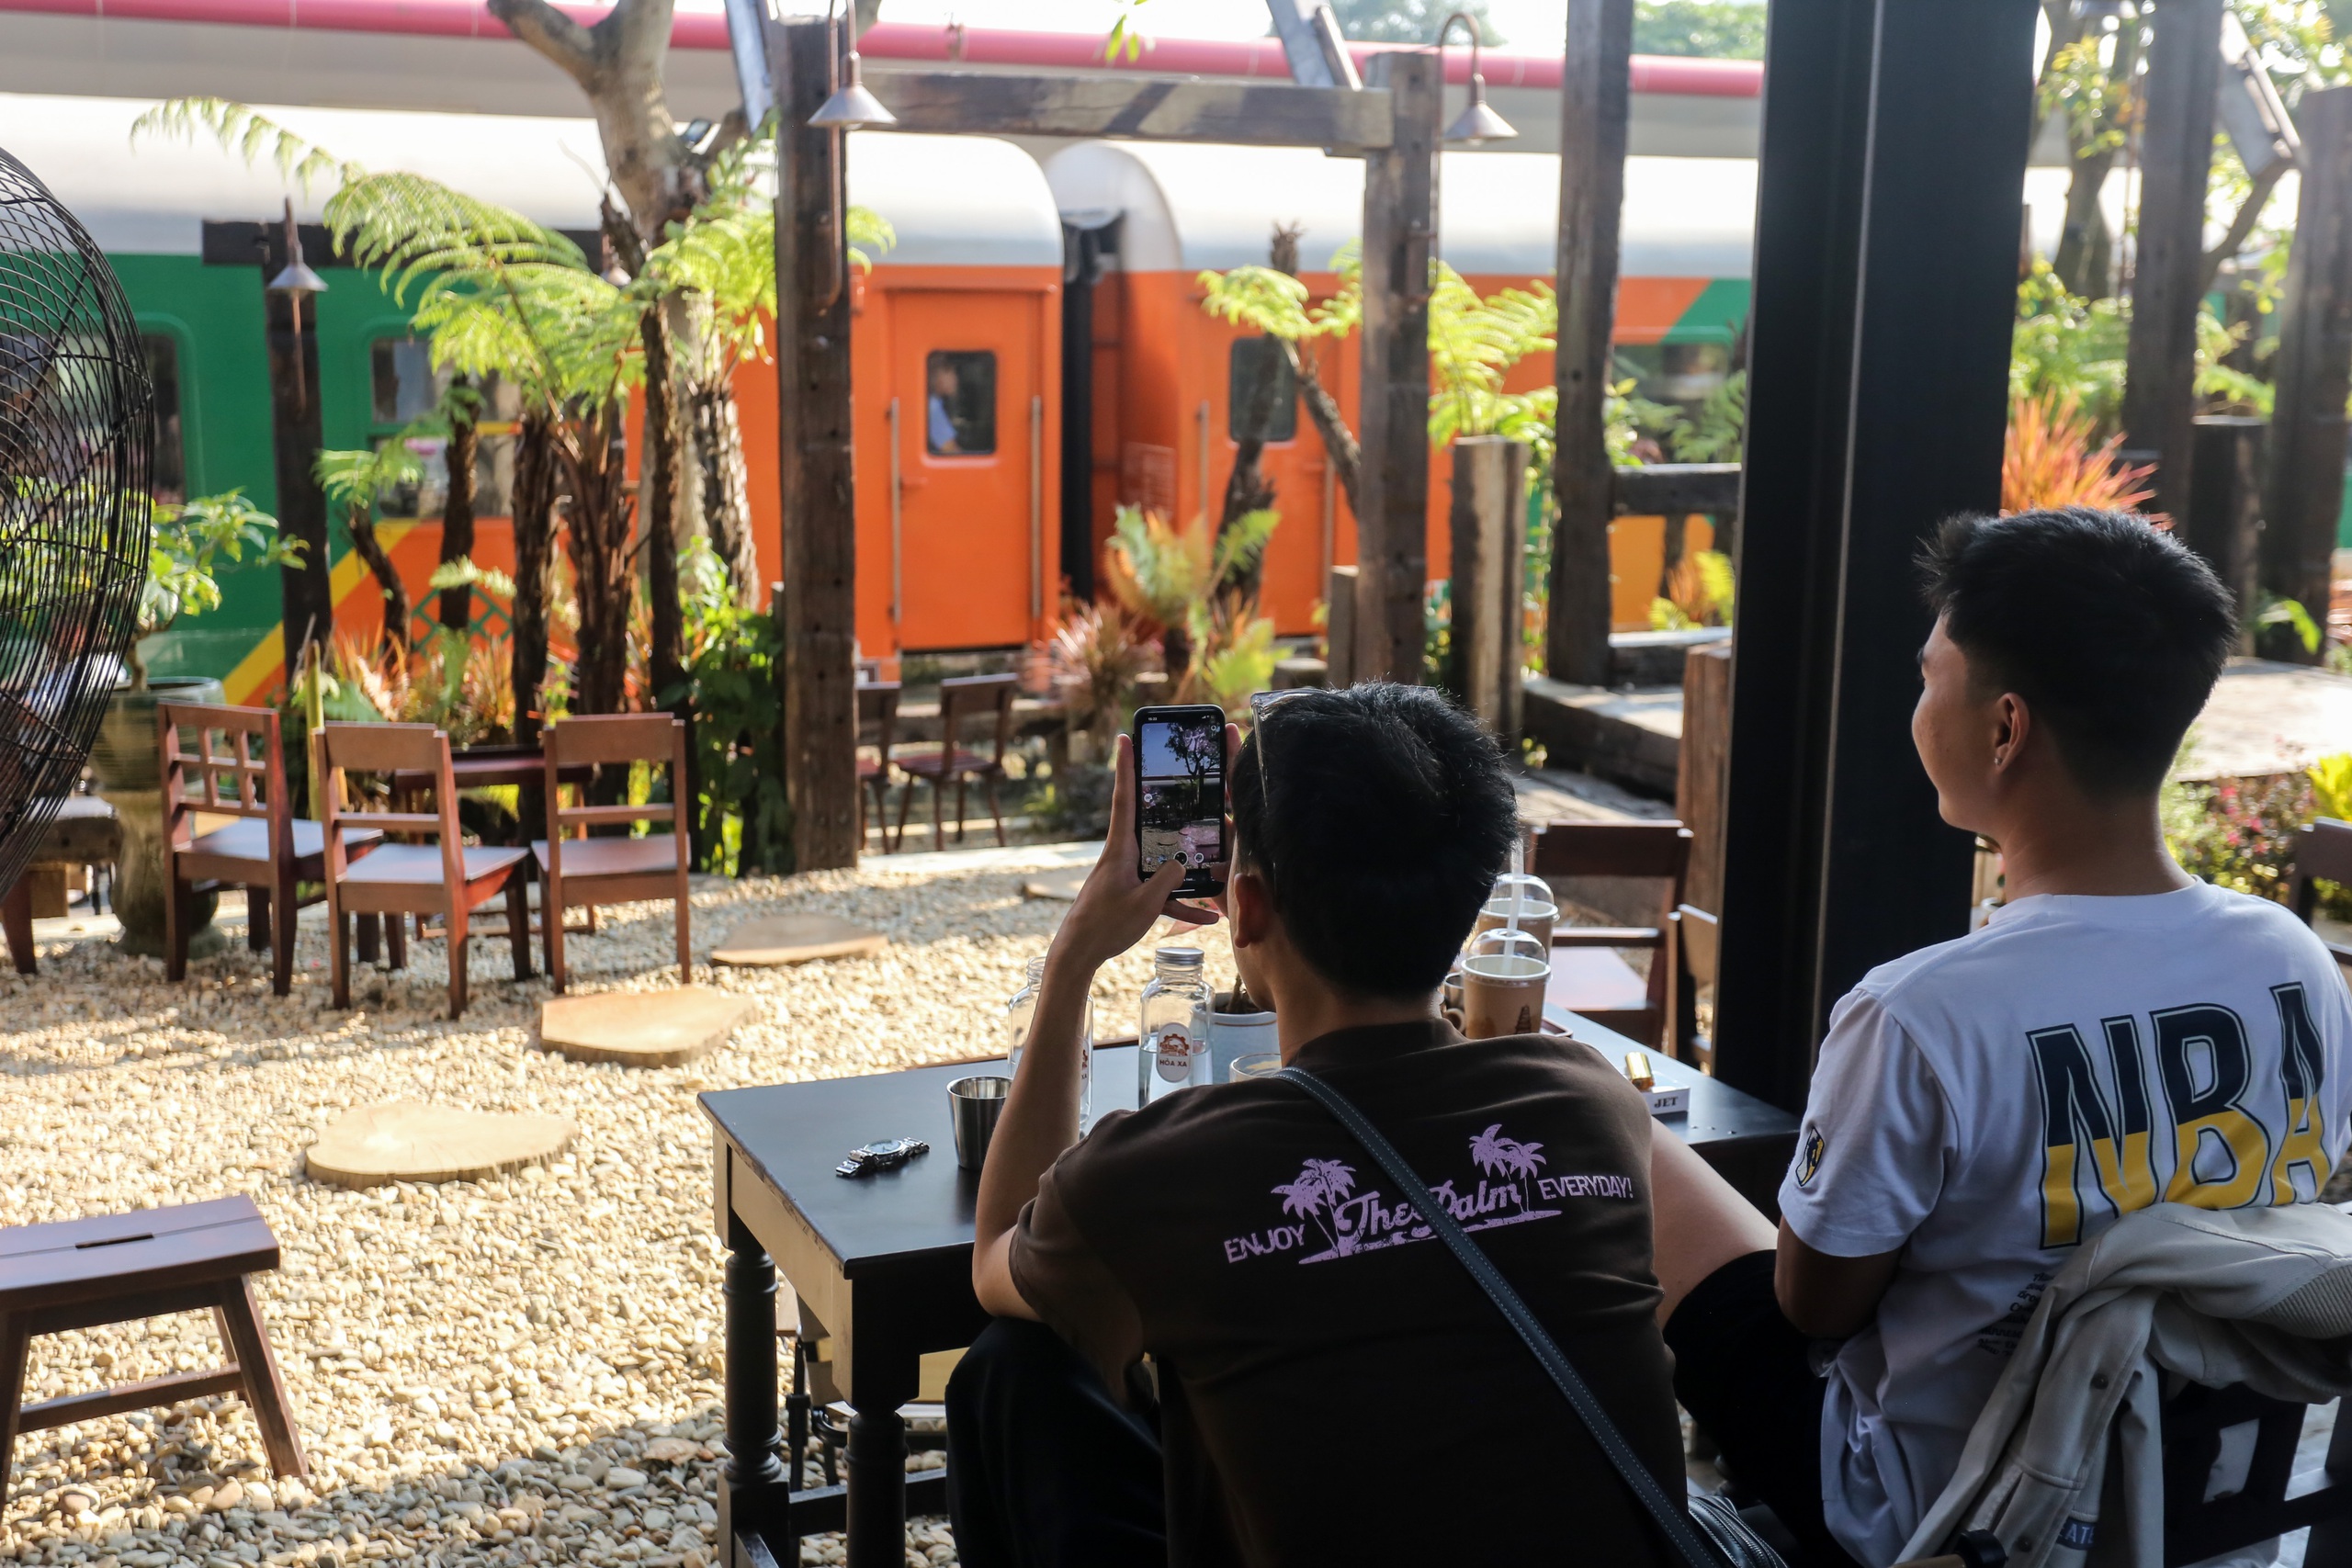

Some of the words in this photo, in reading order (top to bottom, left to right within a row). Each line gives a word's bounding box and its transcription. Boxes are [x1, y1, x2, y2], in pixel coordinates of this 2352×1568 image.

[1654, 1096, 1679, 1108] JET
[2025, 981, 2332, 1250] NBA
[1224, 1224, 1306, 1263] ENJOY
[1335, 1190, 1423, 1238] The
[1537, 1176, 1634, 1201] EVERYDAY!
